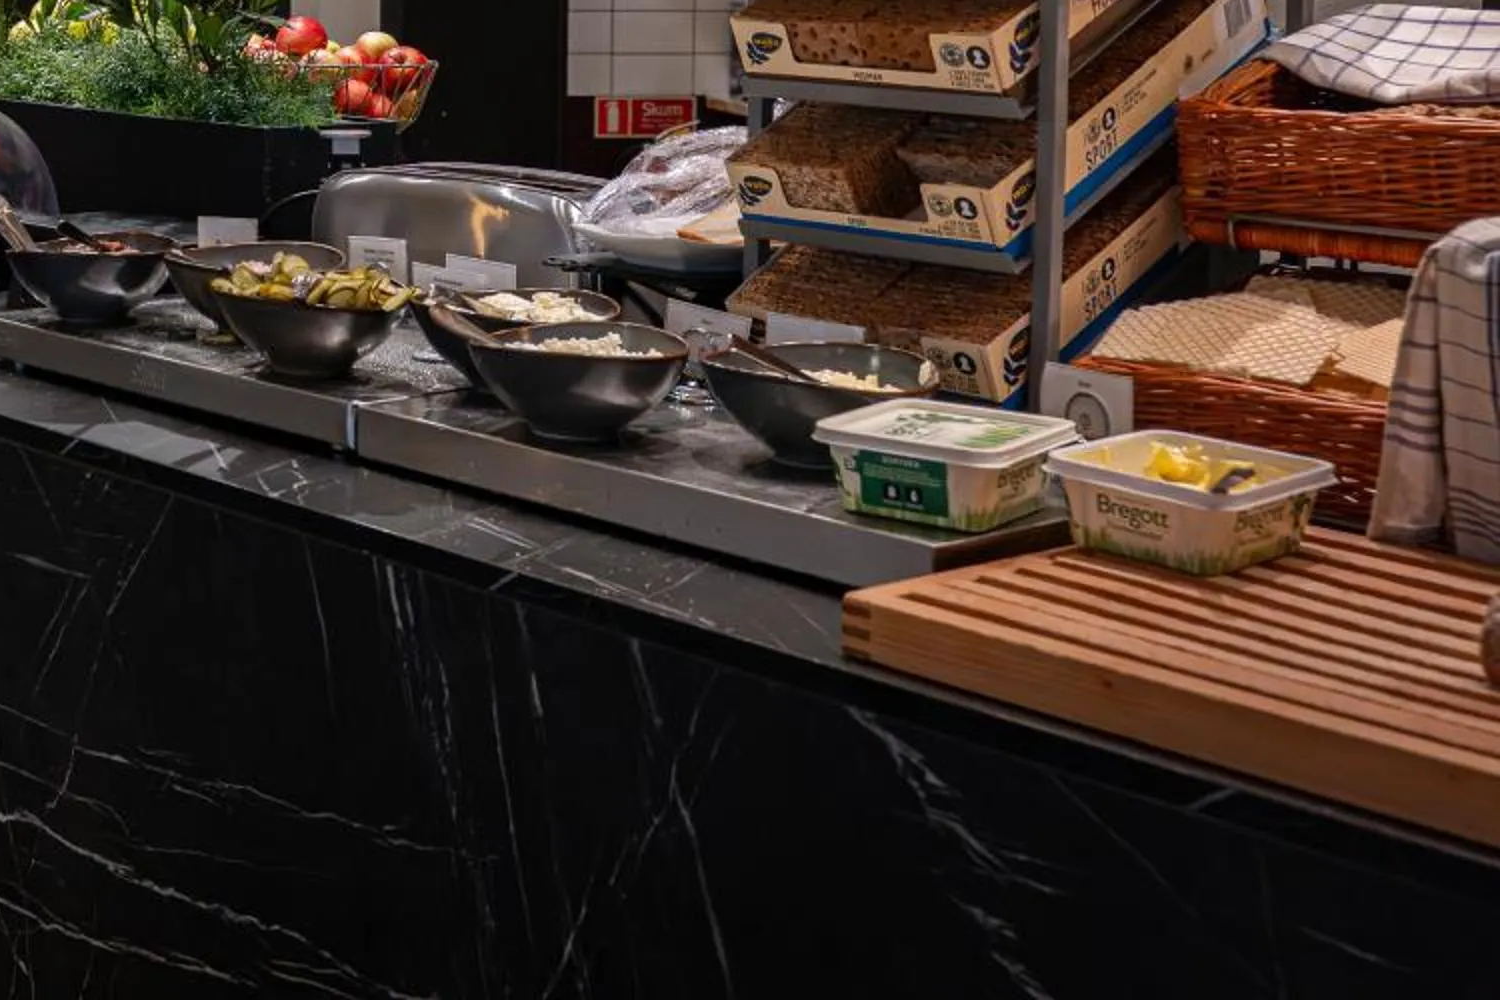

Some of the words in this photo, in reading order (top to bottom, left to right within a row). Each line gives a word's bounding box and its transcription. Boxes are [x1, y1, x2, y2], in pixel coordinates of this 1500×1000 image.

[642, 102, 684, 117] Skum
[1085, 129, 1117, 170] SPORT
[1085, 279, 1116, 321] SPORT
[1097, 493, 1169, 529] Bregott
